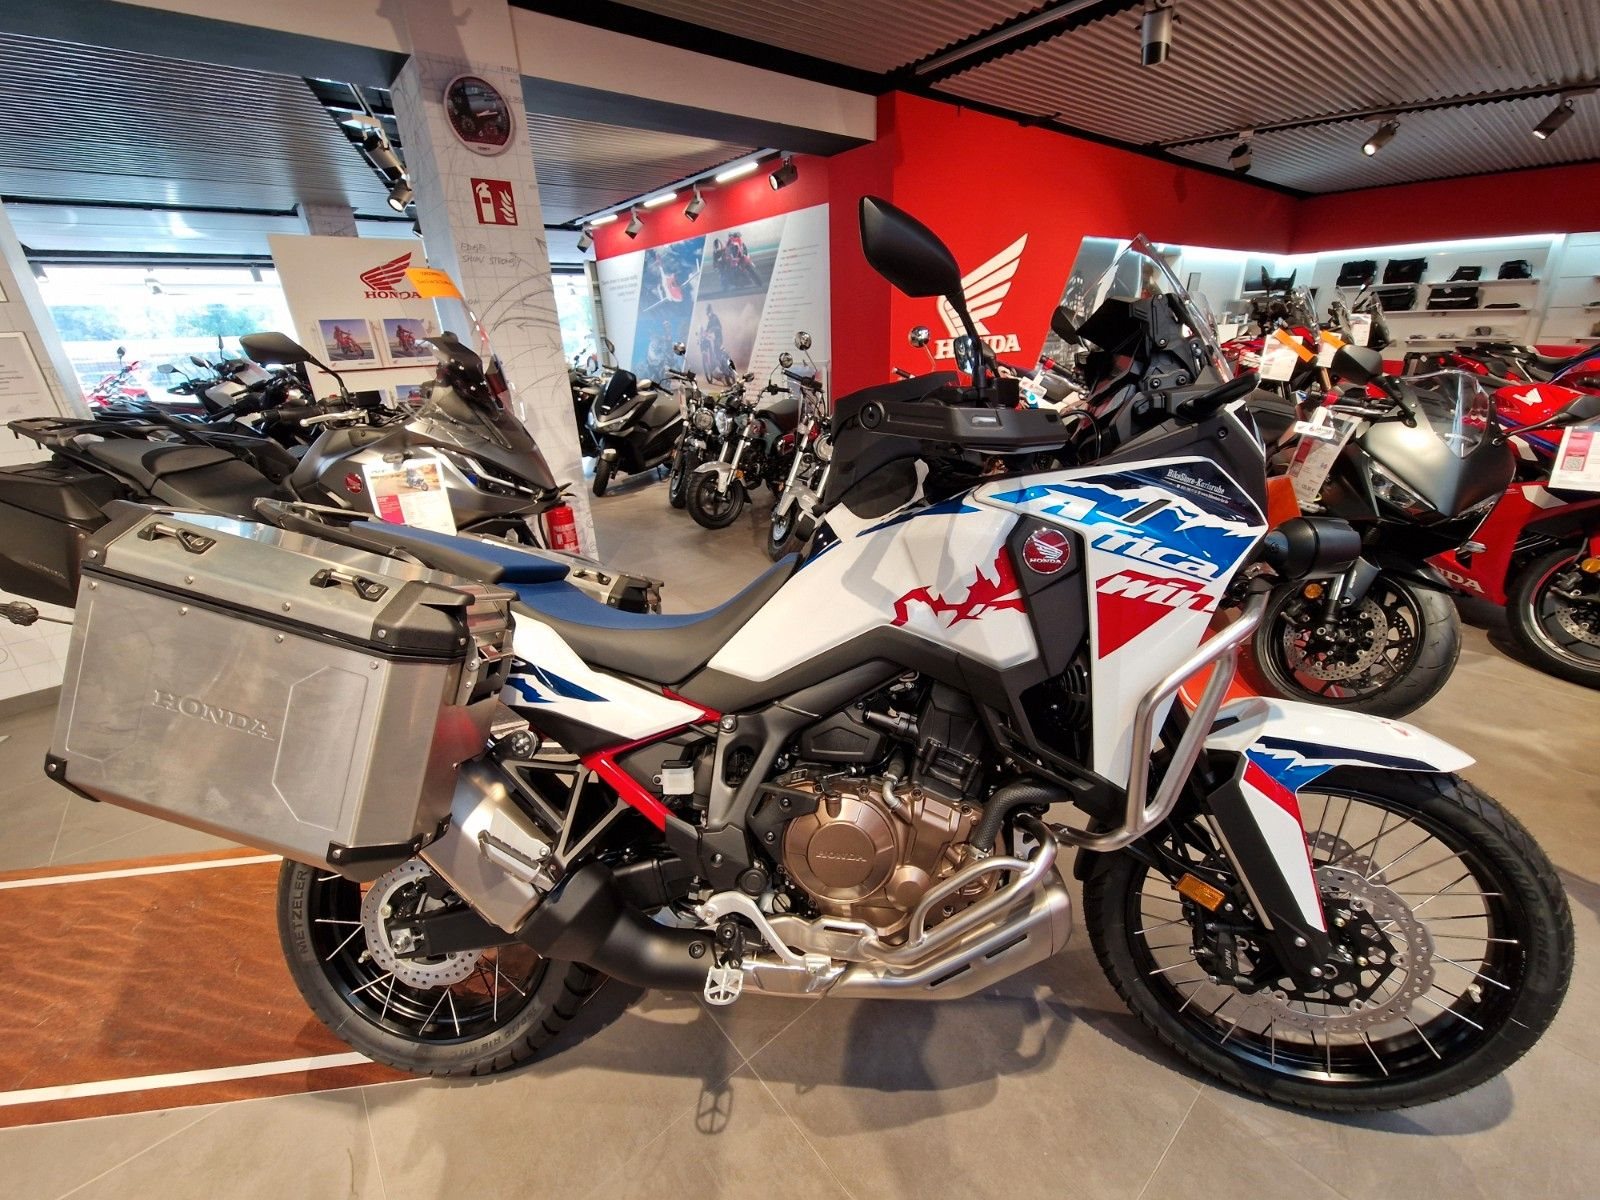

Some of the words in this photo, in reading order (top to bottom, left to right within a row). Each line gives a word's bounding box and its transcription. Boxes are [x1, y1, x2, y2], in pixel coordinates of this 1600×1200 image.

[365, 291, 422, 299] HONDA
[934, 333, 1021, 360] HDA
[1029, 556, 1062, 564] HONDA
[152, 689, 276, 742] HONDA
[815, 851, 868, 863] HONDA
[290, 870, 308, 954] METZELER
